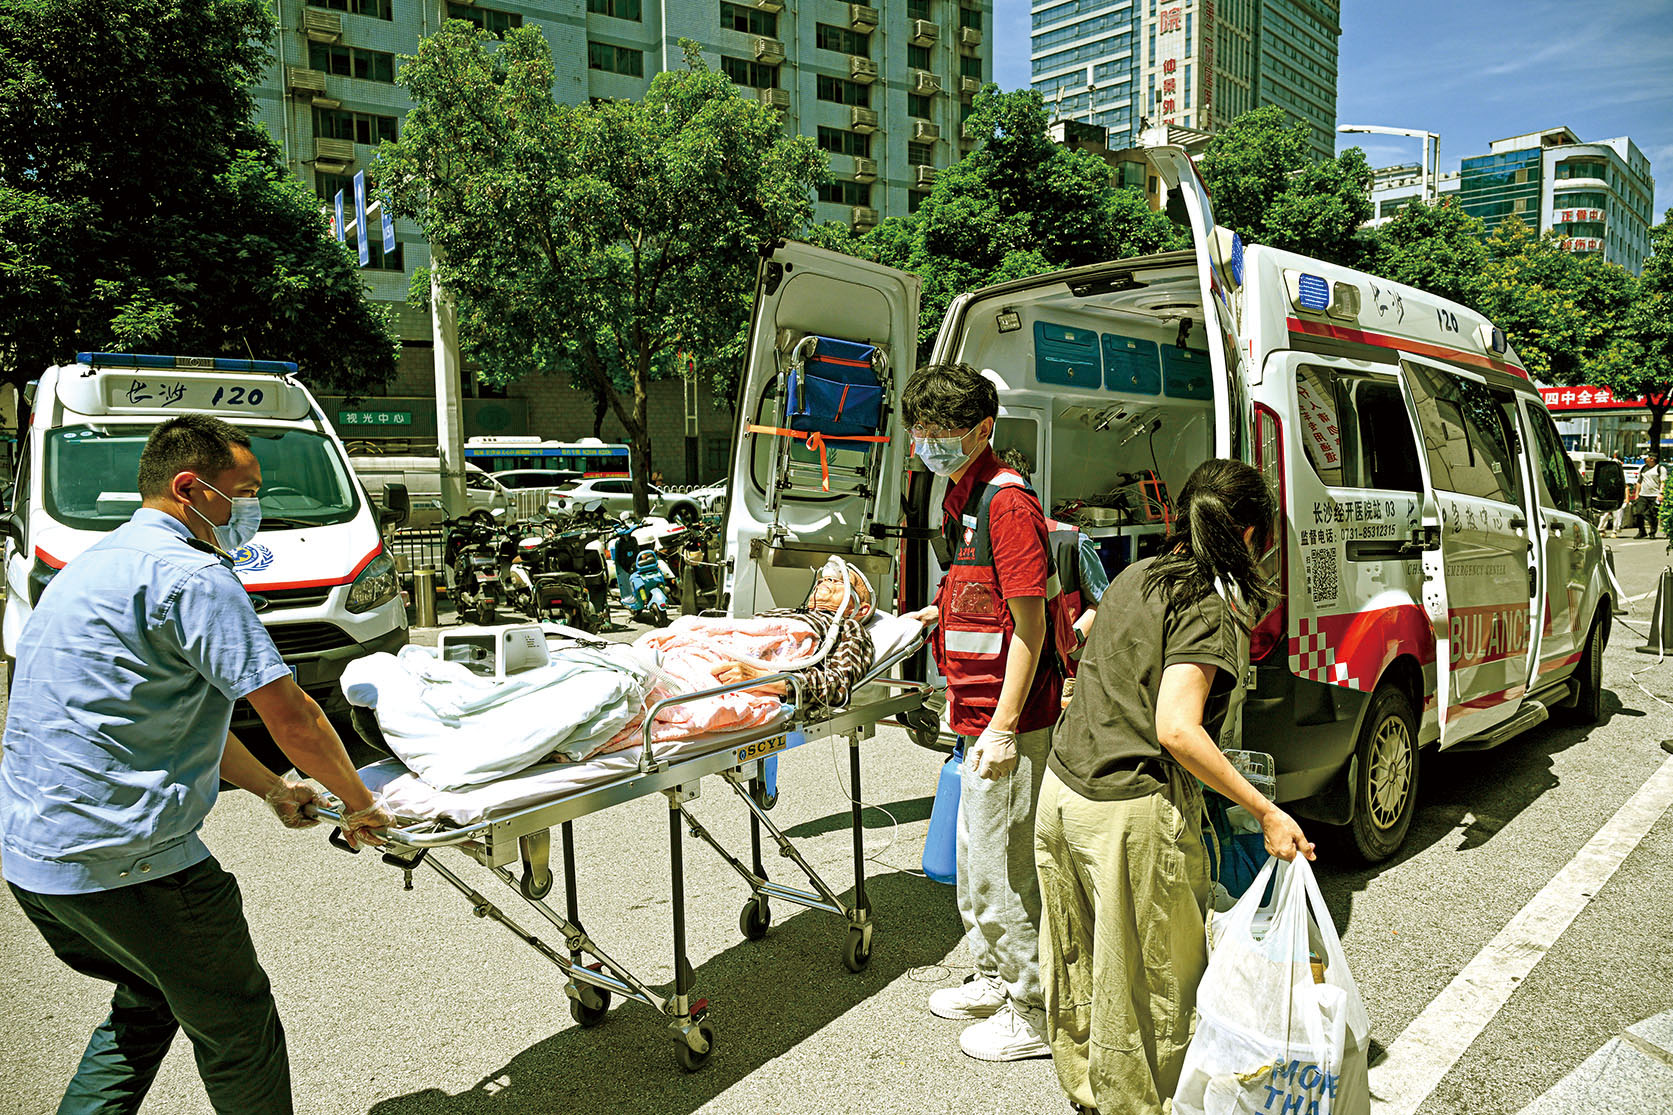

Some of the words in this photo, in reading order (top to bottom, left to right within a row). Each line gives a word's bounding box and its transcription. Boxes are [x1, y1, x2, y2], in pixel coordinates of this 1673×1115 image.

[1160, 0, 1181, 33] 院
[1436, 308, 1459, 333] 120
[126, 379, 188, 408] 长沙
[211, 386, 264, 407] 120
[1540, 390, 1625, 405] 四中全会
[346, 413, 405, 424] 视光中心
[1313, 500, 1382, 525] 长沙经开医院站
[1385, 501, 1396, 517] 03
[1341, 524, 1396, 541] 0731-85312315
[1446, 565, 1483, 577] EMERGENCY
[748, 735, 786, 756] SCYL
[1263, 1084, 1332, 1115] THA
